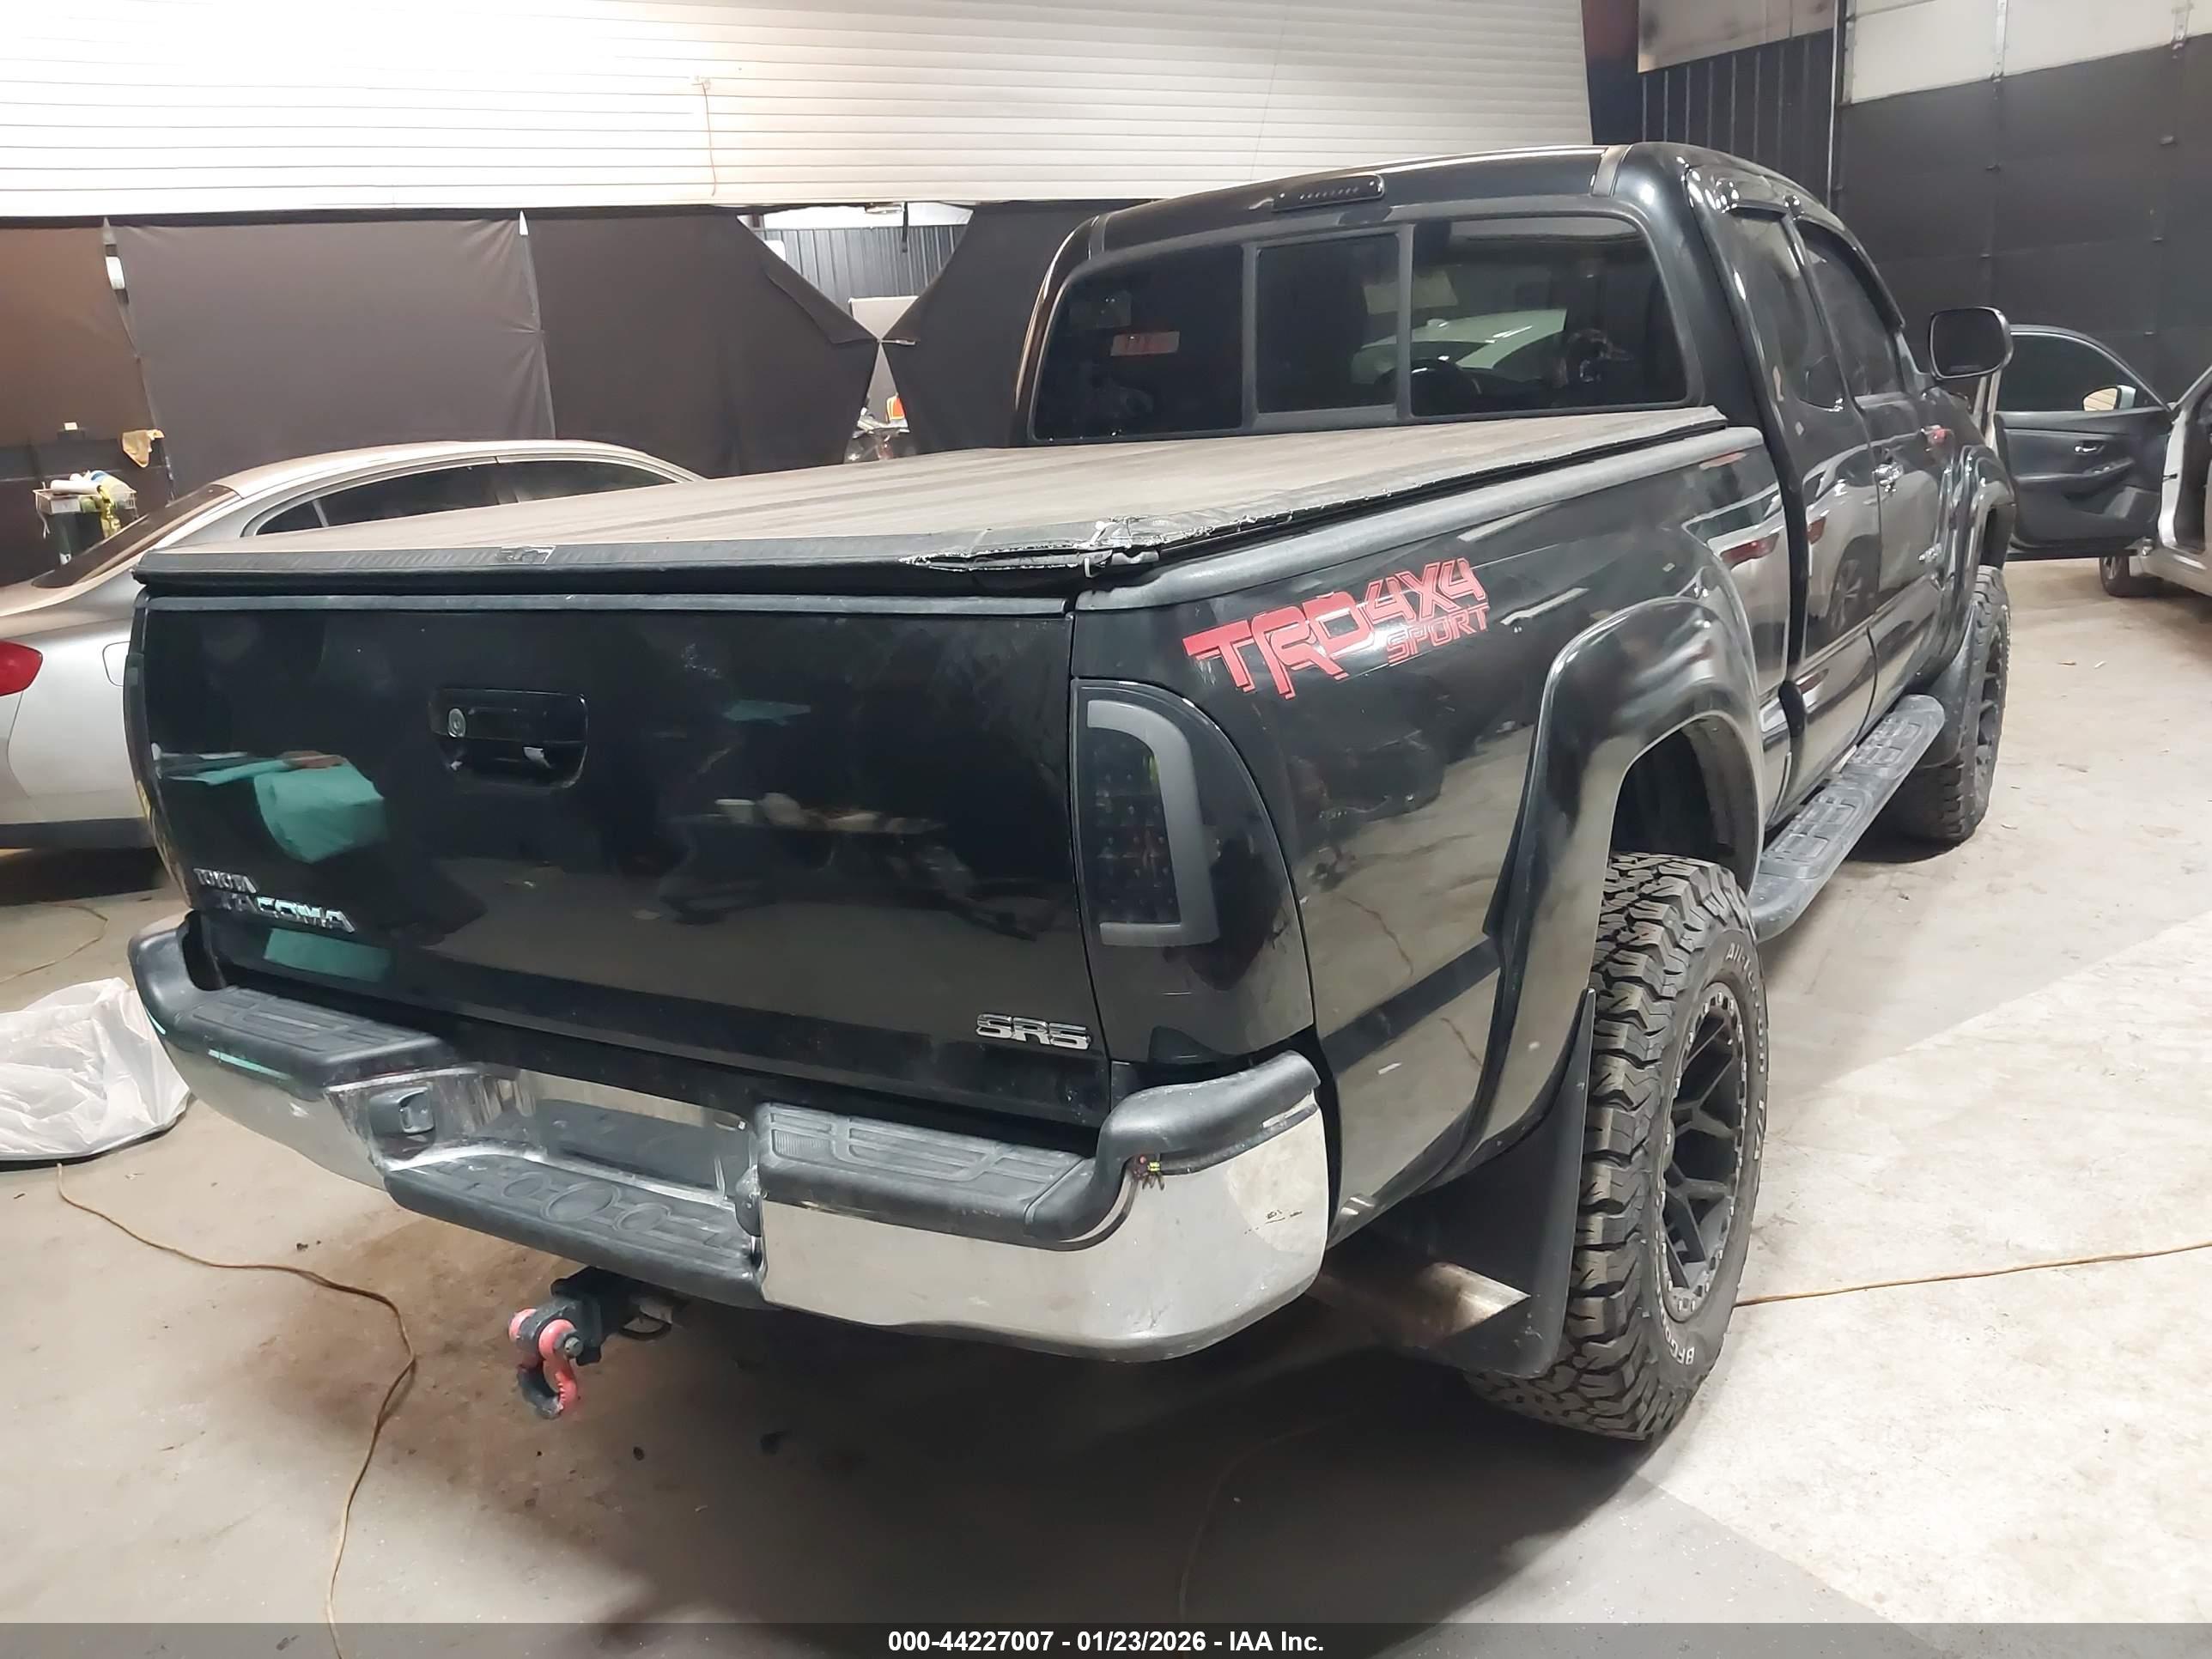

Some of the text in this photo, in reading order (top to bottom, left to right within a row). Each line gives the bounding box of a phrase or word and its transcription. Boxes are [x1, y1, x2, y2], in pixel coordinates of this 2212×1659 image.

[1182, 557, 1487, 700] TRD 4X4
[1386, 604, 1491, 666] SPORT
[192, 867, 258, 894] TOYOTA
[218, 893, 356, 933] TACOMA
[975, 1012, 1092, 1050] SR5
